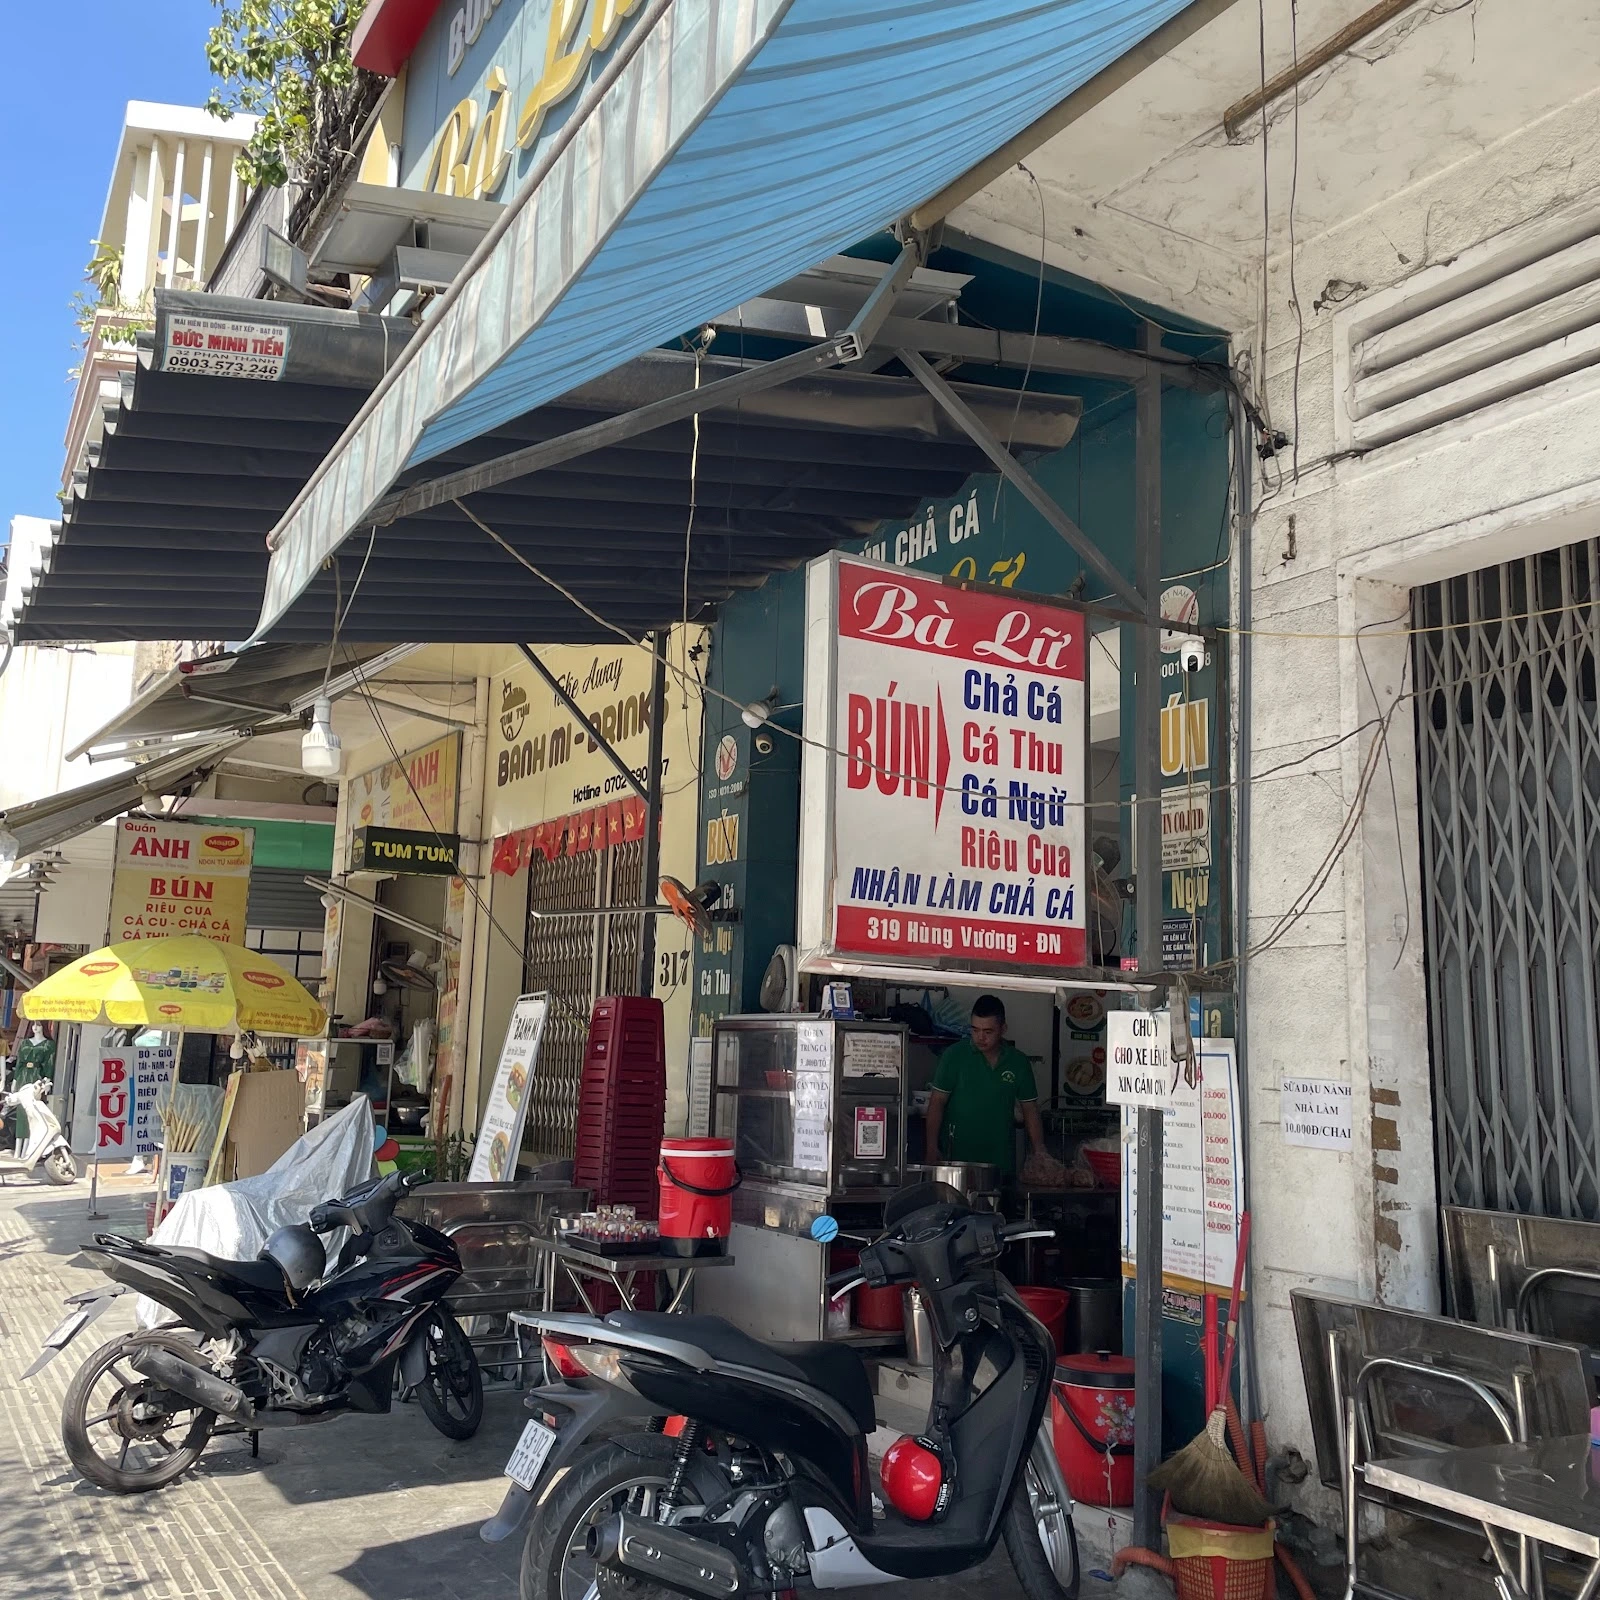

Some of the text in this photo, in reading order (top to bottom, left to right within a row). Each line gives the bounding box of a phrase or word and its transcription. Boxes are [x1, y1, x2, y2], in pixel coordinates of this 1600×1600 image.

[172, 329, 285, 357] ĐỨC MINH TIẾN
[169, 356, 279, 375] 0903.573.246
[894, 489, 980, 567] CHẢ CÁ
[852, 581, 1072, 670] Bà Lữ
[582, 656, 624, 692] Away
[963, 669, 1062, 724] Chả Cá
[847, 680, 930, 800] BÚN
[1160, 692, 1209, 777] ÚN
[962, 721, 1063, 775] Cá Thu
[405, 749, 440, 796] ANH
[572, 783, 601, 805] Hotline
[961, 773, 1067, 831] Cá Ngừ
[124, 822, 156, 833] Quán
[130, 836, 190, 860] ANH
[371, 841, 454, 863] TUM TUM
[961, 825, 1071, 878] Riêu Cua
[149, 875, 214, 900] BÚN
[850, 866, 1075, 921] NHẬN LÀM CHẢ CÁ
[1171, 869, 1209, 914] Ngừ
[145, 901, 212, 916] RIÊU CUA
[124, 914, 231, 931] CÁ CU CHẢ CÁ
[122, 929, 142, 940] CÁ
[867, 916, 1061, 955] 319 Hùng Vương ĐN
[700, 968, 731, 996] Cá Thu
[1114, 1046, 1133, 1065] CHO
[1135, 1048, 1148, 1066] XE
[138, 1071, 169, 1083] CHẢ CÁ
[1118, 1076, 1132, 1093] XIN
[1134, 1072, 1153, 1095] CẢM
[1283, 1080, 1301, 1092] SỮA
[97, 1057, 128, 1148] BÚN
[137, 1086, 157, 1097] RIÊU
[1203, 1091, 1226, 1099] 25.000
[1203, 1111, 1227, 1120] 20.000
[1294, 1101, 1339, 1116] NHÀ LÀM
[1205, 1136, 1229, 1144] 25.000
[1285, 1122, 1352, 1139] 10.000Đ/CHAI
[1207, 1200, 1232, 1211] 45.000
[1206, 1221, 1232, 1232] 40.000
